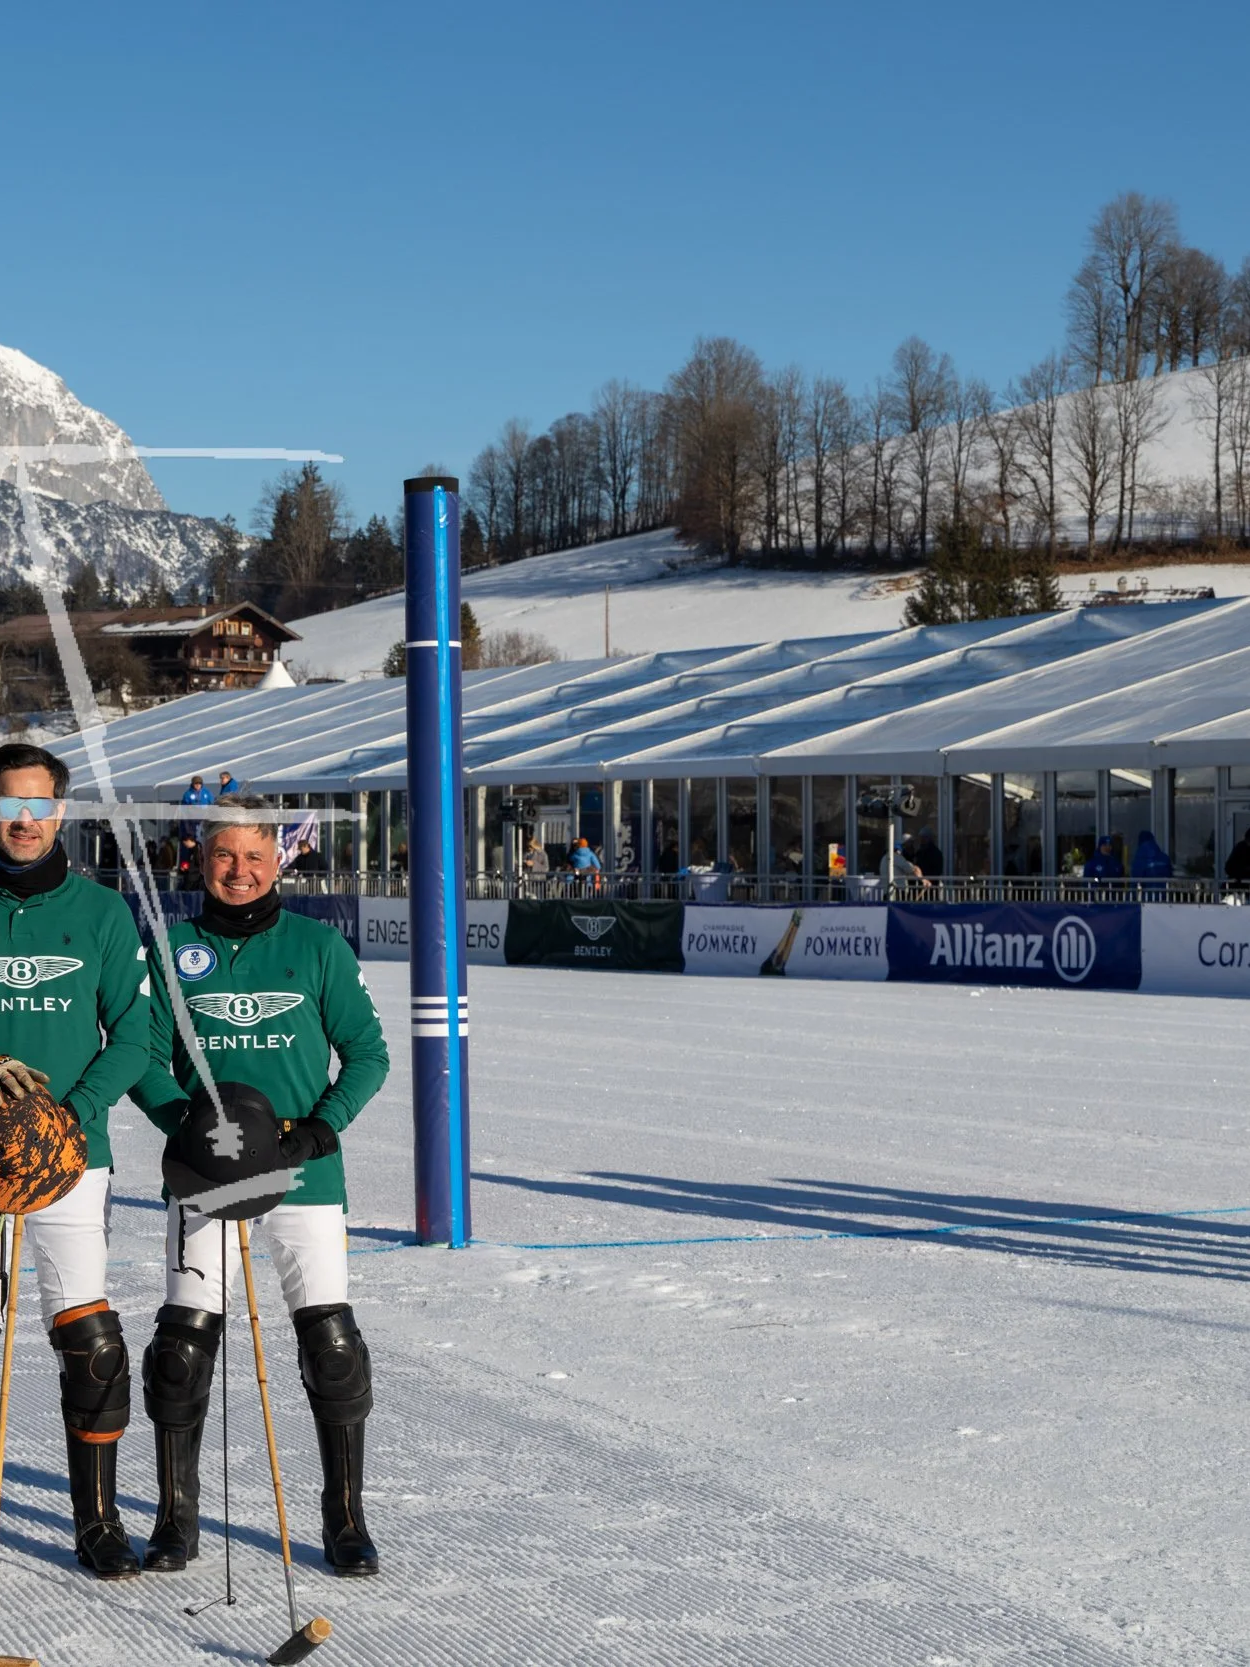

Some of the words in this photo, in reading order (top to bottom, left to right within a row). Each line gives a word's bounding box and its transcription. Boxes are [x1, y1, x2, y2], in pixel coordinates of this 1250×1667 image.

[367, 918, 409, 945] ENGE
[466, 923, 500, 950] ERS
[703, 924, 745, 933] CHAMPAGNE
[819, 925, 867, 934] CHAMPAGNE
[573, 946, 612, 957] BENTLEY
[687, 933, 758, 955] POMMERY
[804, 936, 882, 957] POMMERY
[929, 923, 1044, 969] Allianz
[1198, 931, 1250, 968] Car
[195, 1034, 296, 1051] BENTLEY
